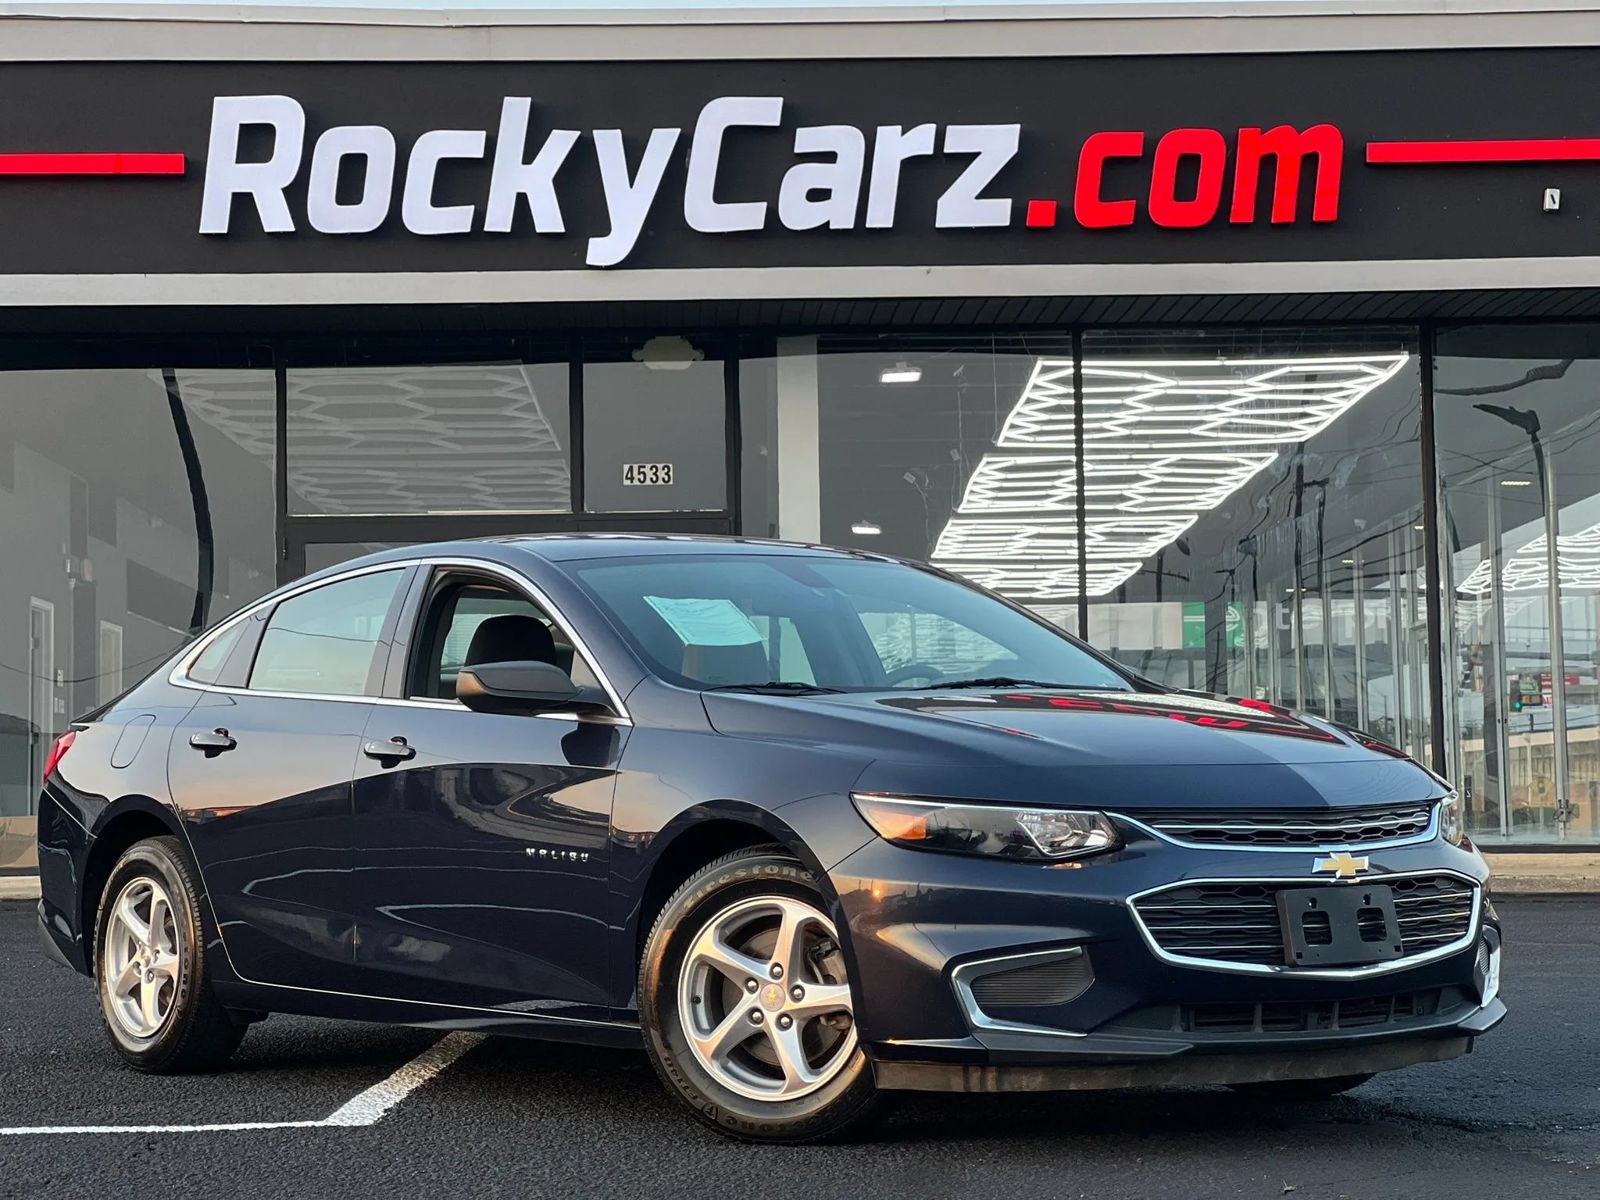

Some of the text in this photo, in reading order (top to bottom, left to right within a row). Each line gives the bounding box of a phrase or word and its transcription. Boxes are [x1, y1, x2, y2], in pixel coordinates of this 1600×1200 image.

[199, 95, 1343, 266] RockyCarz.com
[624, 464, 672, 484] 4533
[525, 848, 589, 862] MALIBU
[682, 863, 816, 910] Firestone
